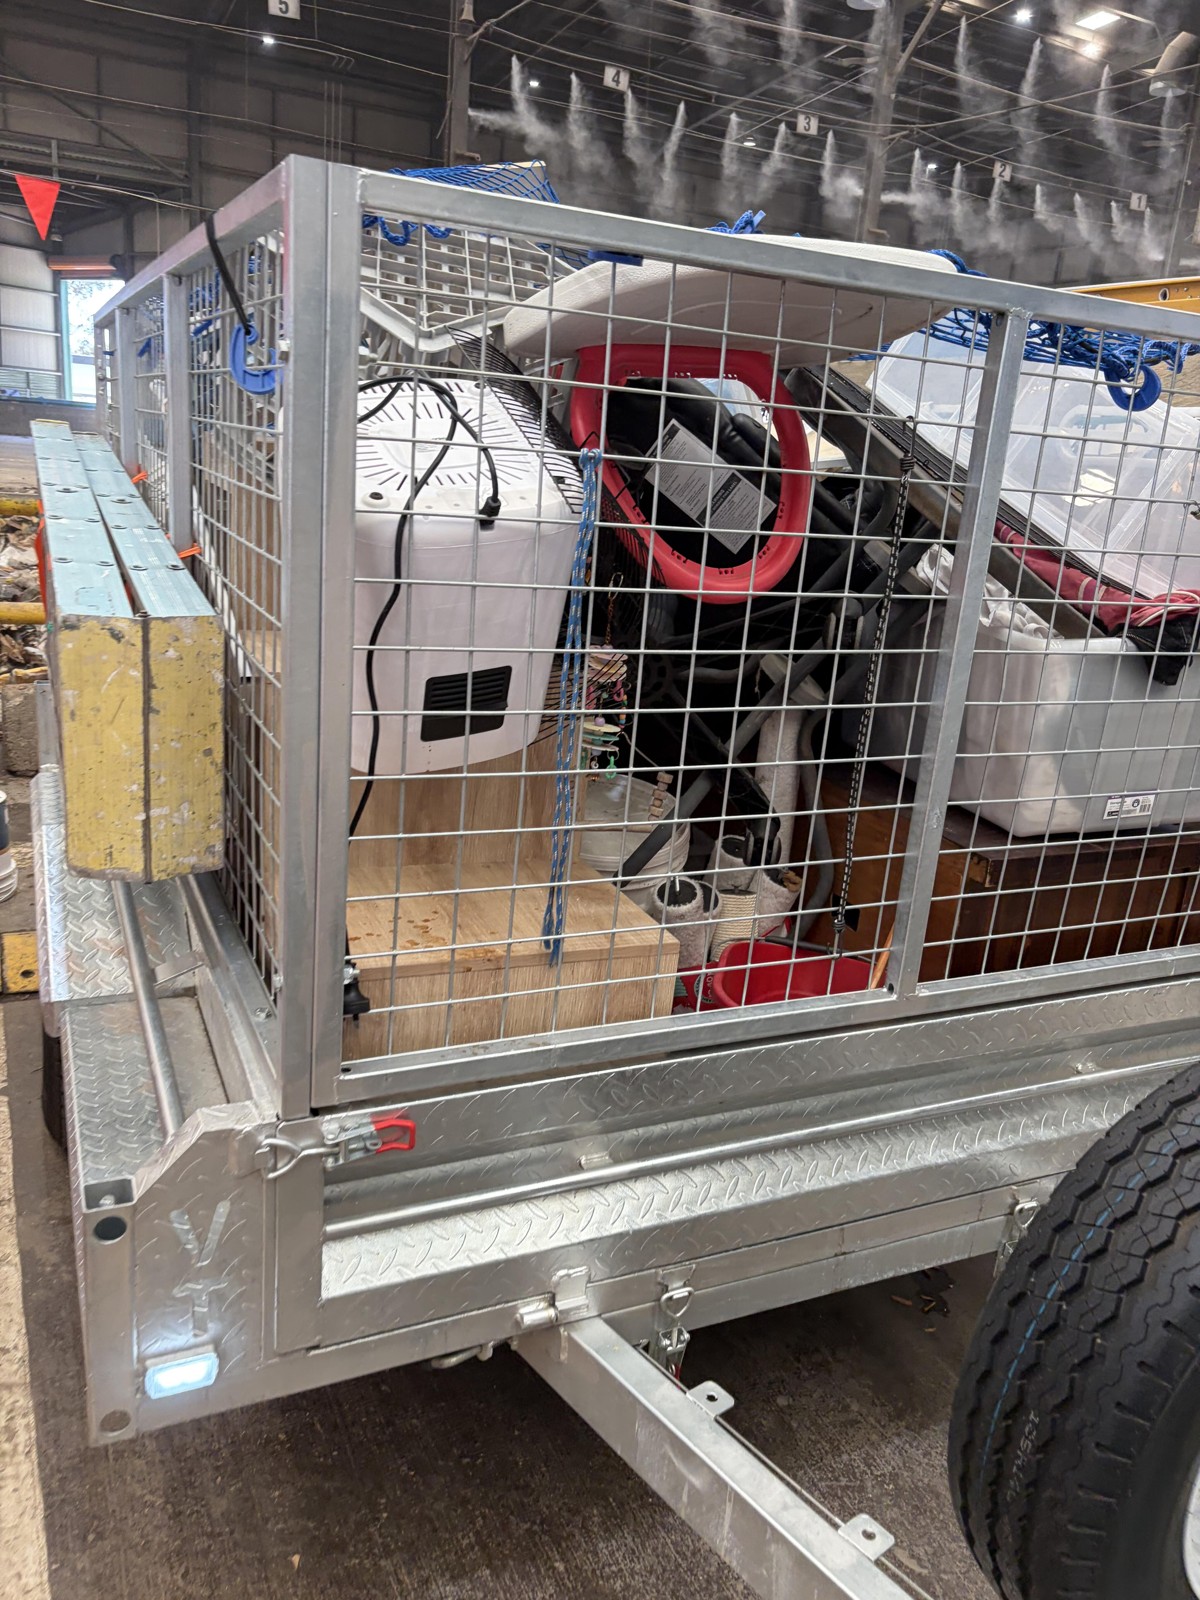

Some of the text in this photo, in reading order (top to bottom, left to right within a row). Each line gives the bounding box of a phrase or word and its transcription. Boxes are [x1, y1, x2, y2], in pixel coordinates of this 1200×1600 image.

[278, 0, 290, 15] 5
[611, 69, 621, 87] 4
[803, 115, 812, 132] 3
[998, 162, 1007, 178] 2
[1136, 195, 1143, 209] 1
